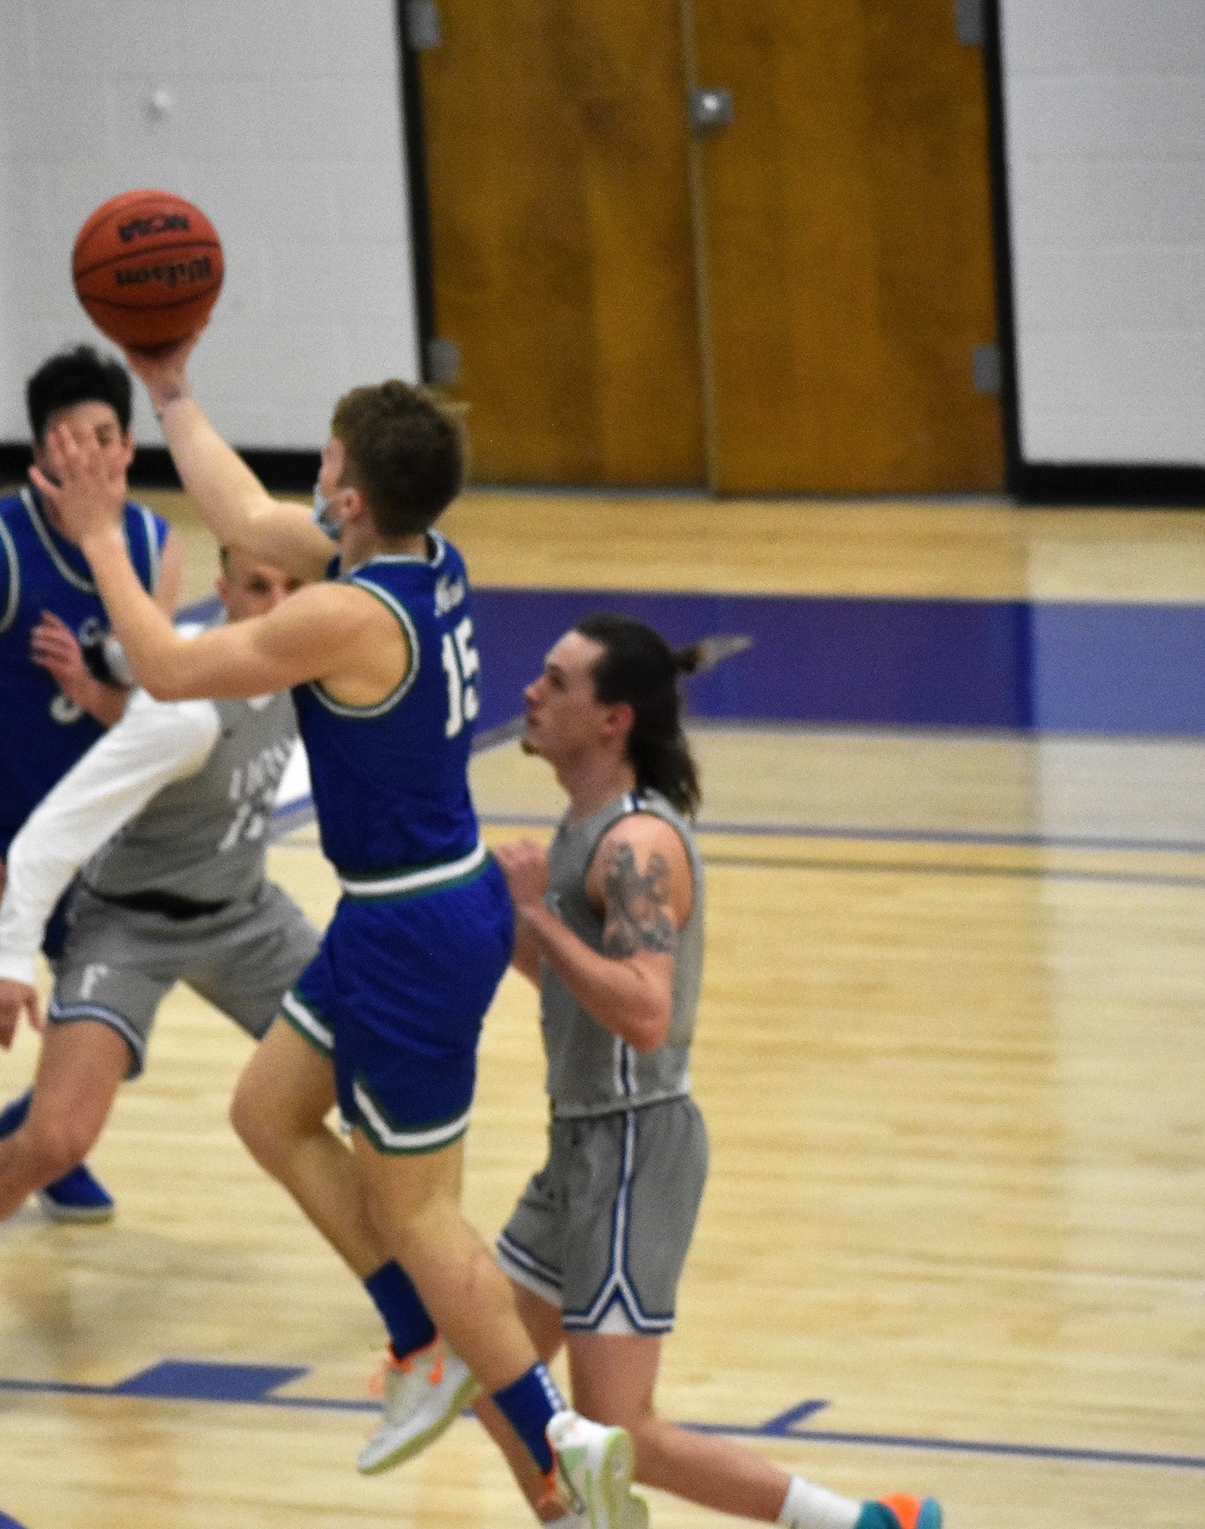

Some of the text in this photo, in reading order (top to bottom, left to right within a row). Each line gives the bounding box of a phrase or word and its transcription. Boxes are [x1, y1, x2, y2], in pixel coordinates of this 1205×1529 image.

[117, 213, 190, 243] NCAA
[114, 255, 211, 288] Wilson
[441, 614, 481, 740] 15
